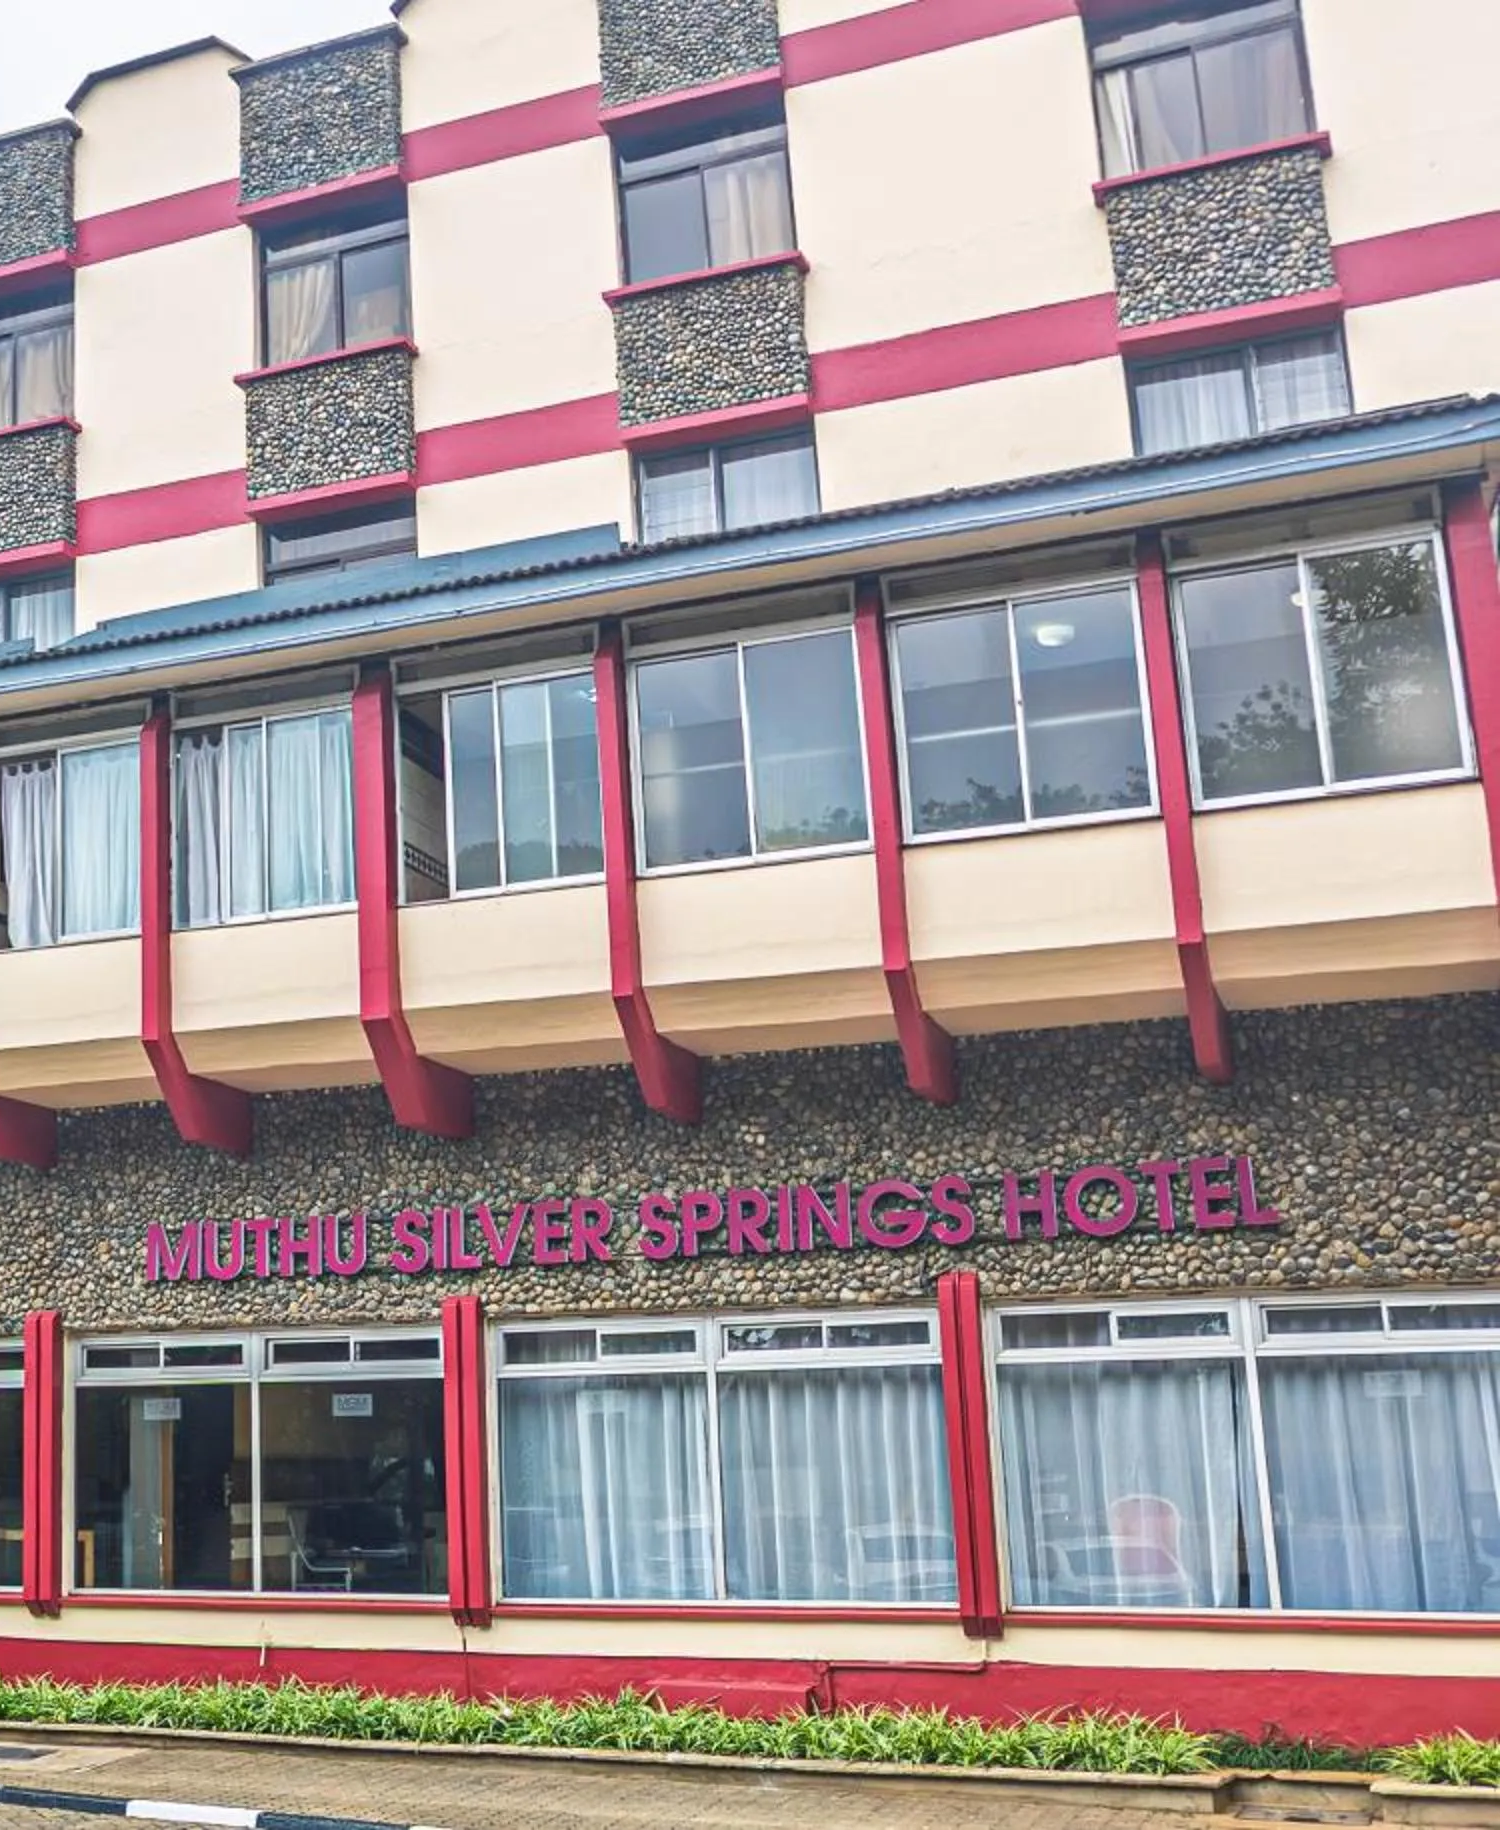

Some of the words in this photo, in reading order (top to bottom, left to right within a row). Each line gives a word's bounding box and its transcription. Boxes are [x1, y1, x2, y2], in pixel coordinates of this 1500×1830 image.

[145, 1214, 367, 1283] MUTHU
[390, 1199, 612, 1274] SILVER
[638, 1176, 976, 1261] SPRINGS
[1002, 1156, 1280, 1241] HOTEL
